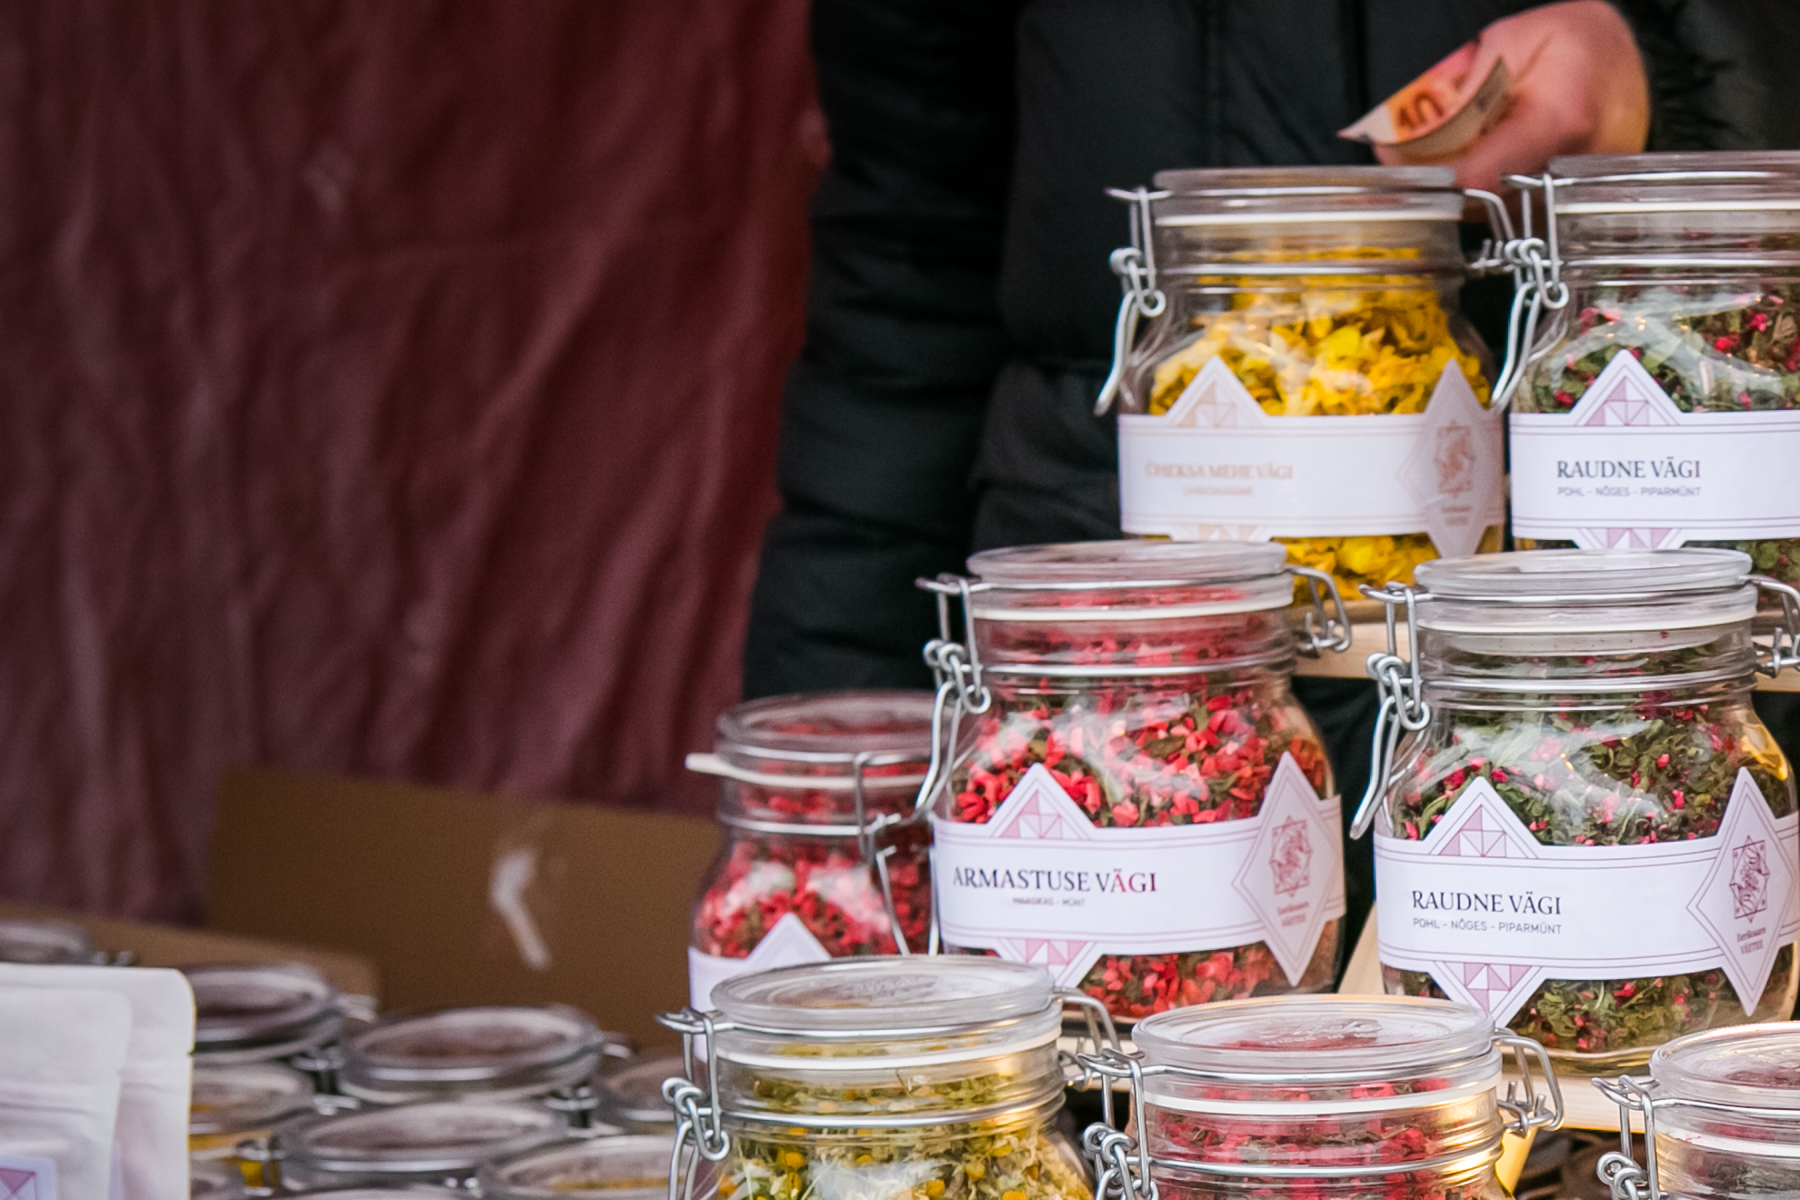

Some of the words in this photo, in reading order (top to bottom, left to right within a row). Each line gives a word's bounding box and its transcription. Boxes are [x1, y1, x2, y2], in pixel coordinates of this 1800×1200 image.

[1557, 460, 1646, 479] RAUDNE
[1651, 457, 1700, 479] VÄGI
[1641, 484, 1700, 497] PIPARMÜNT
[952, 866, 1090, 893] ARMASTUSE
[1095, 867, 1157, 893] VÄGI
[1412, 890, 1503, 913] RAUDNE
[1509, 890, 1561, 915] VÄGI
[1413, 917, 1440, 929] POHL
[1450, 916, 1487, 931] NÕGES
[1499, 920, 1562, 934] PIPARMÜNT
